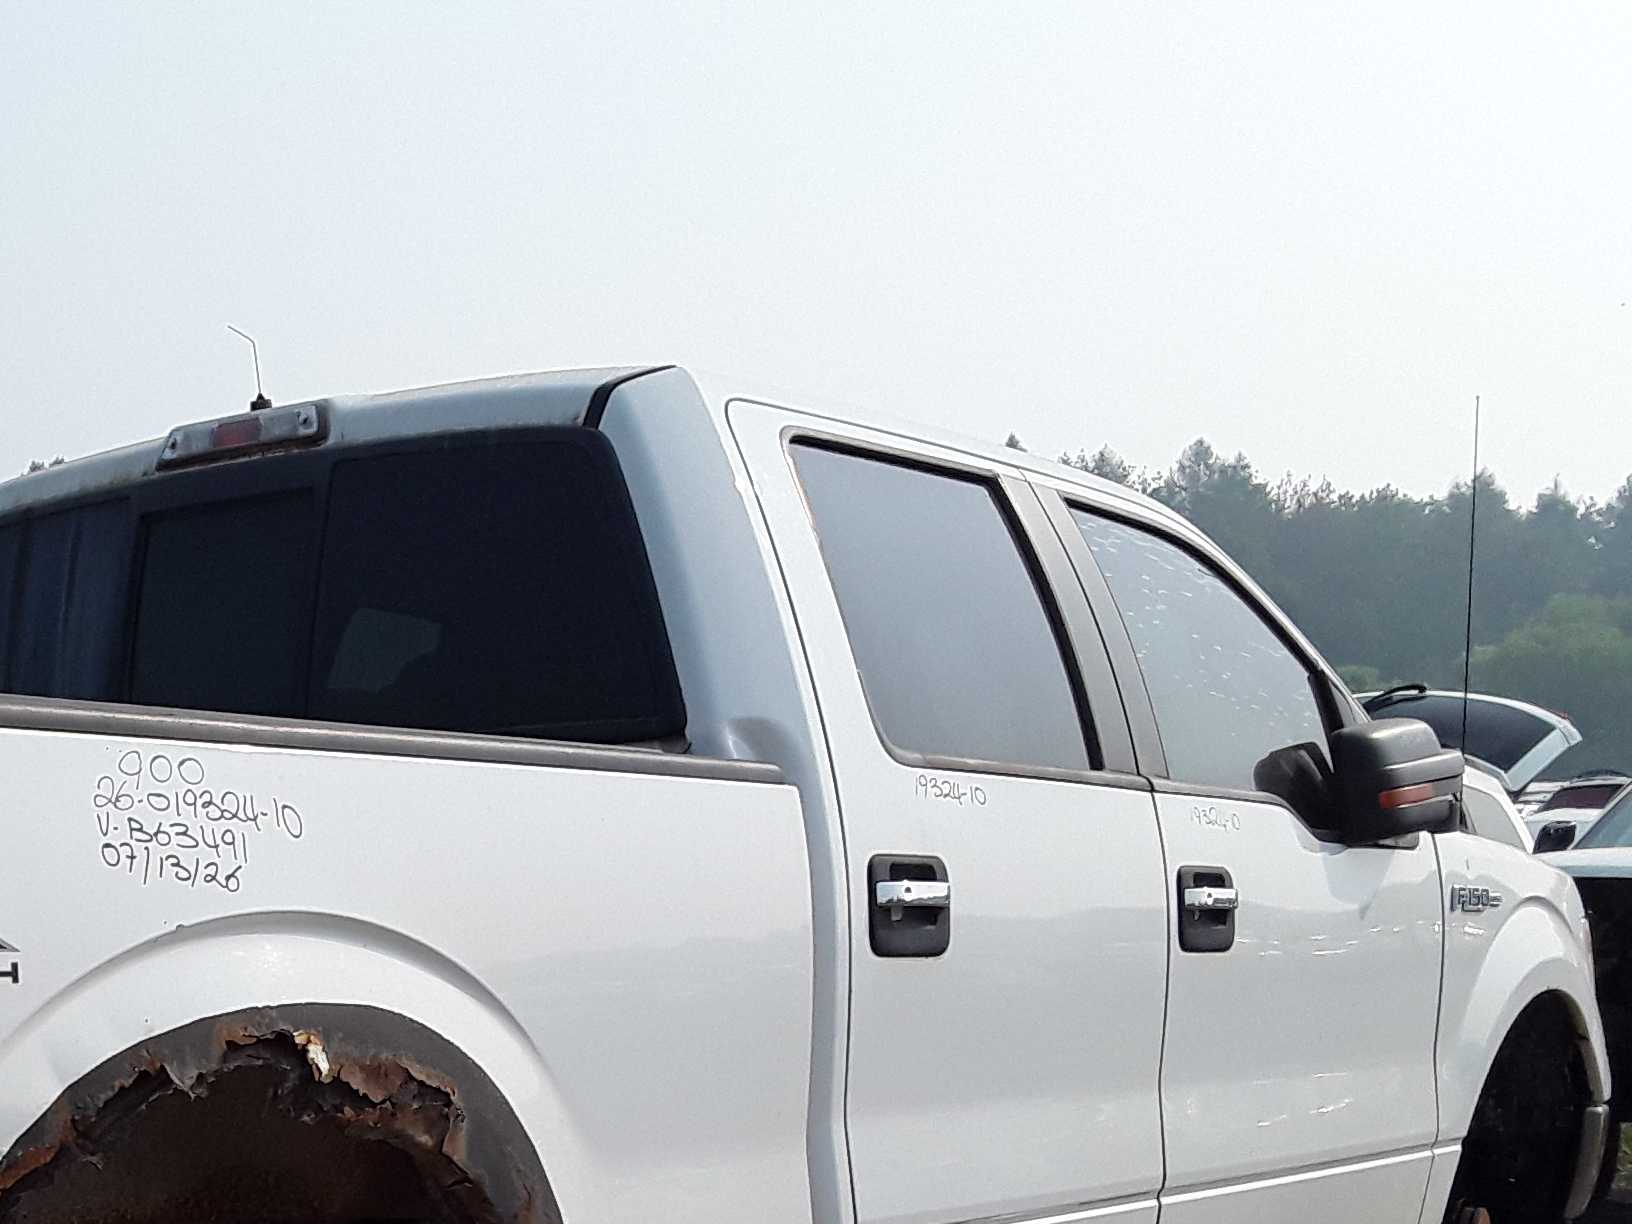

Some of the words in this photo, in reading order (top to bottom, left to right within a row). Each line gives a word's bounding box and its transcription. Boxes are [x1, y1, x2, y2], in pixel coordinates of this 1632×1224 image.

[118, 750, 205, 790] 900
[914, 774, 987, 806] 19324-10
[93, 775, 303, 839] 26-019324-10
[101, 842, 243, 893] 07/13/26
